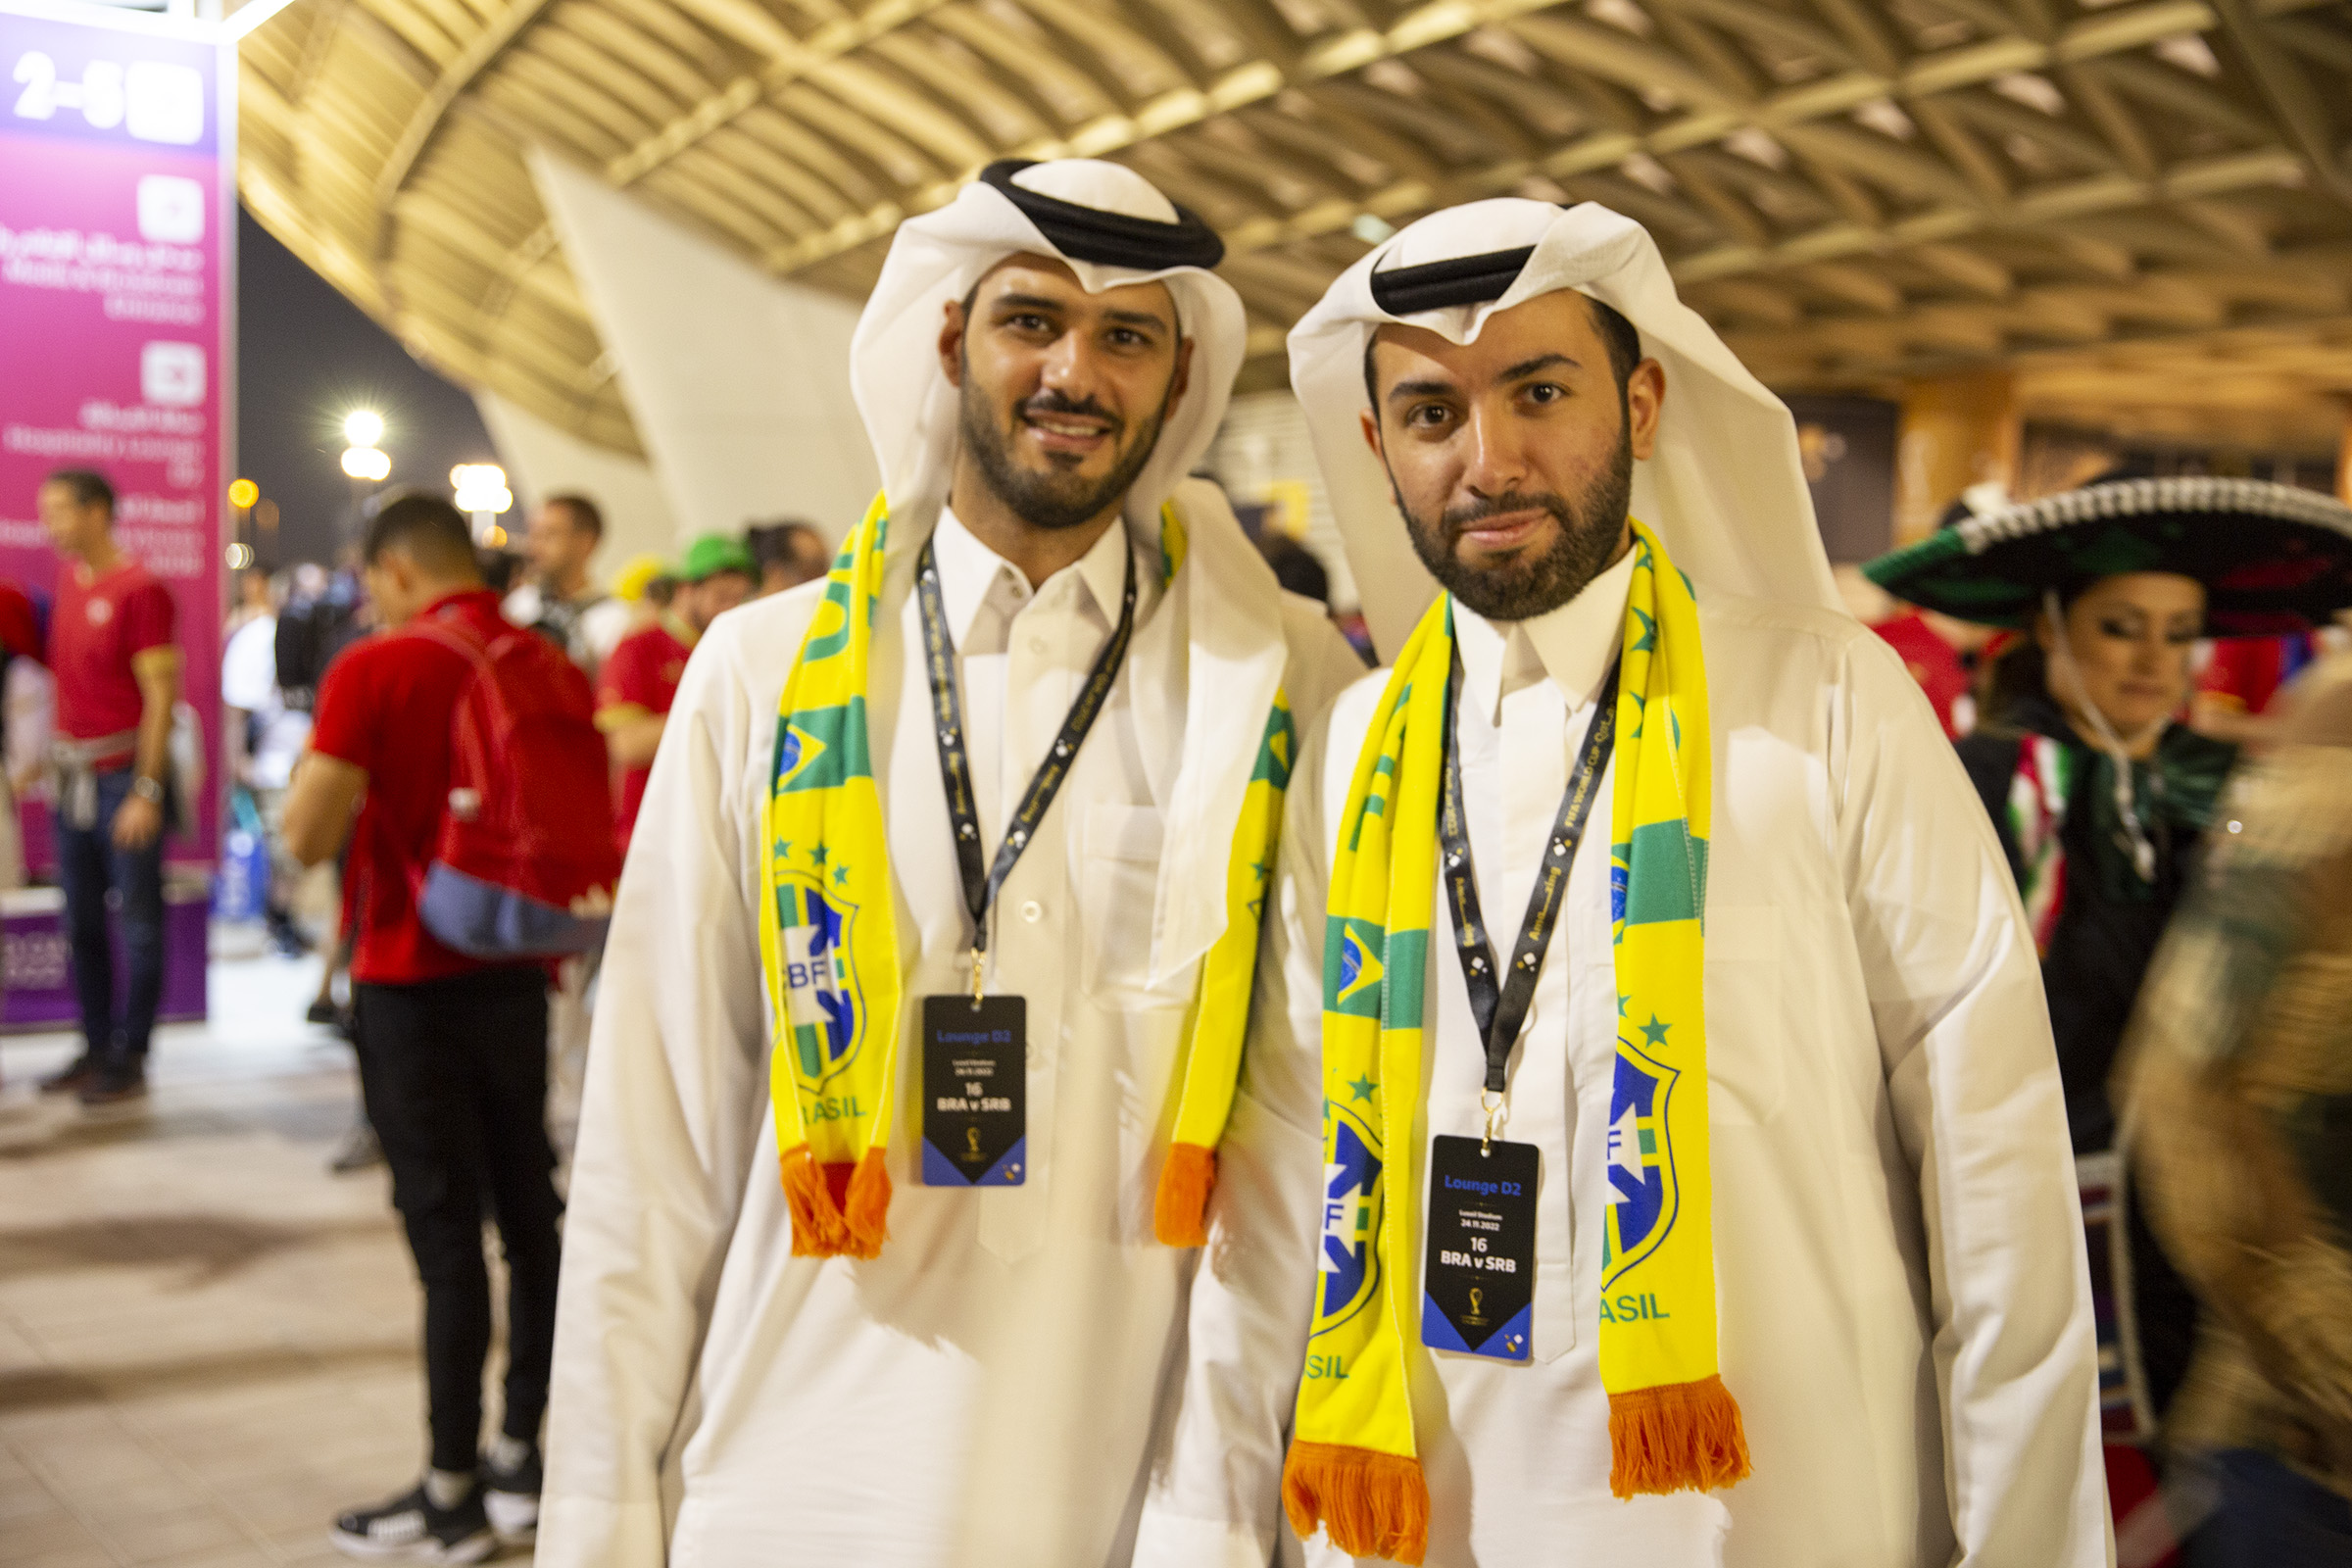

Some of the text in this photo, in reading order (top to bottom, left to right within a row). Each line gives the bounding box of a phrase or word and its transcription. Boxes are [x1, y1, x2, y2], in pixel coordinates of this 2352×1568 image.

[783, 961, 826, 988] BF
[803, 1097, 866, 1124] ASIL
[937, 1098, 969, 1111] BRA
[981, 1098, 1011, 1111] SRB
[1445, 1175, 1522, 1197] Lounge D2
[1470, 1237, 1488, 1252] 16
[1441, 1250, 1516, 1273] BRA v SRB
